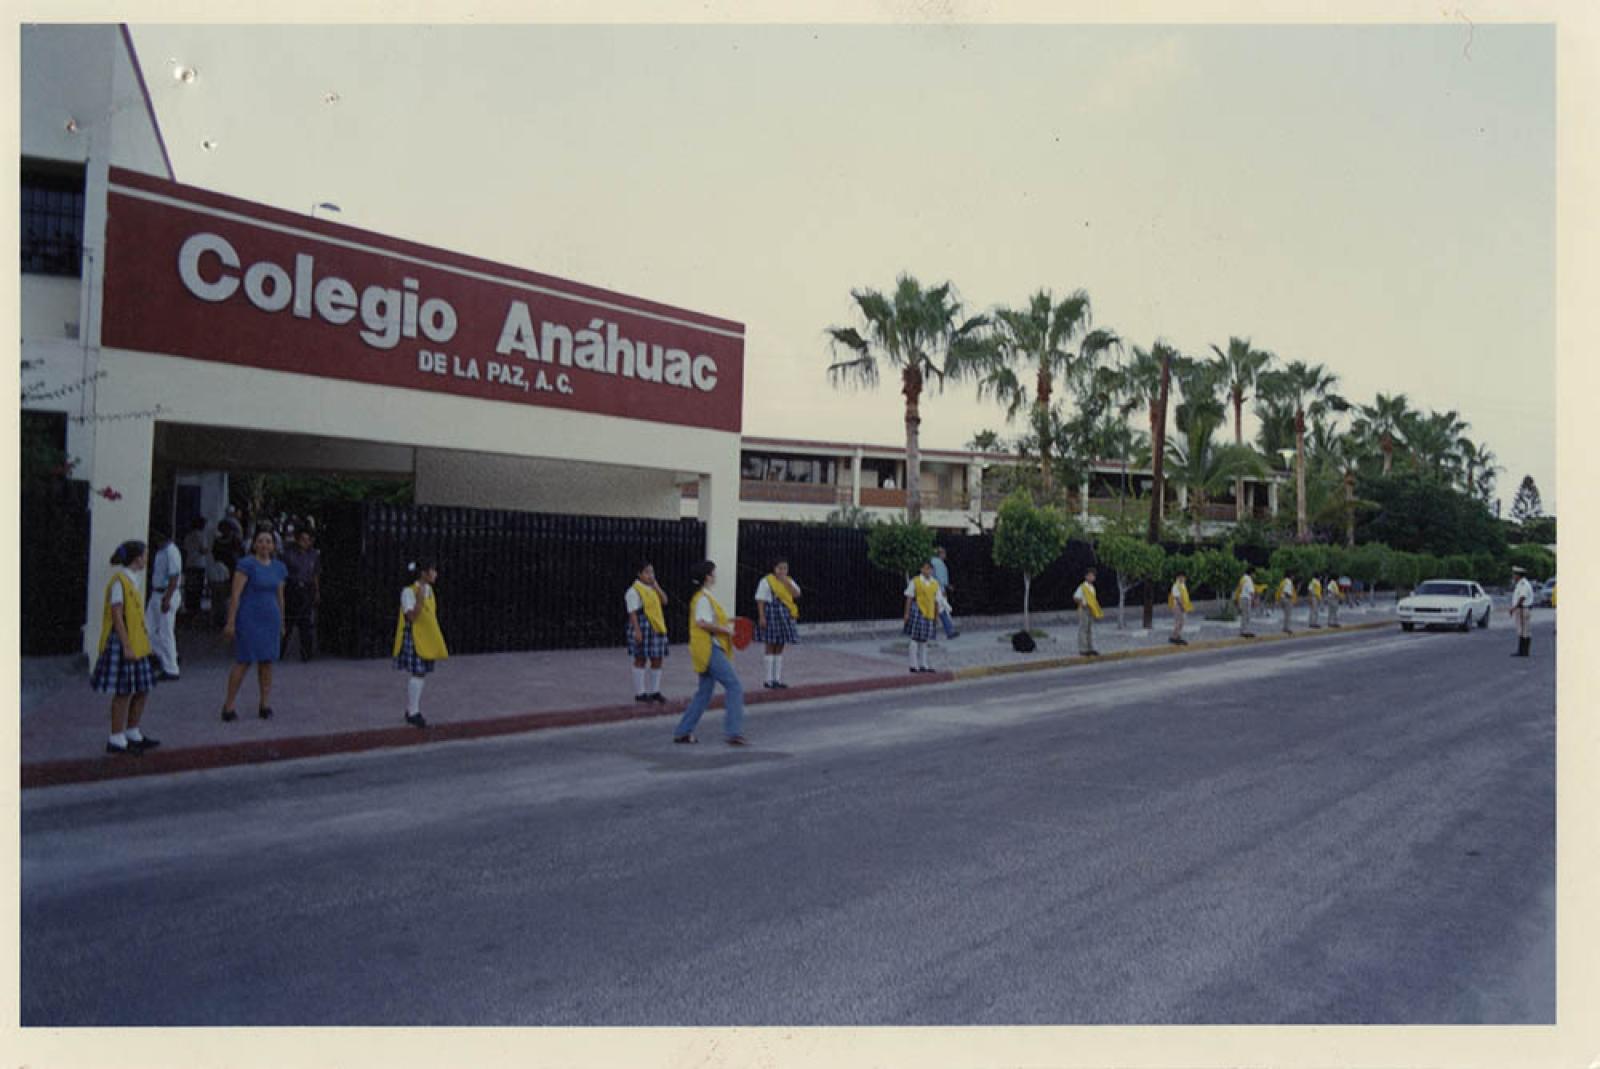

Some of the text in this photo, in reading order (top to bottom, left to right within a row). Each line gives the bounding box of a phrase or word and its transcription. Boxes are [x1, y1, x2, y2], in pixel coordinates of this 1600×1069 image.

[178, 233, 718, 392] Colegio Anáhuac
[418, 350, 447, 374] DE
[453, 356, 480, 379] LA
[487, 361, 529, 392] PAZ,
